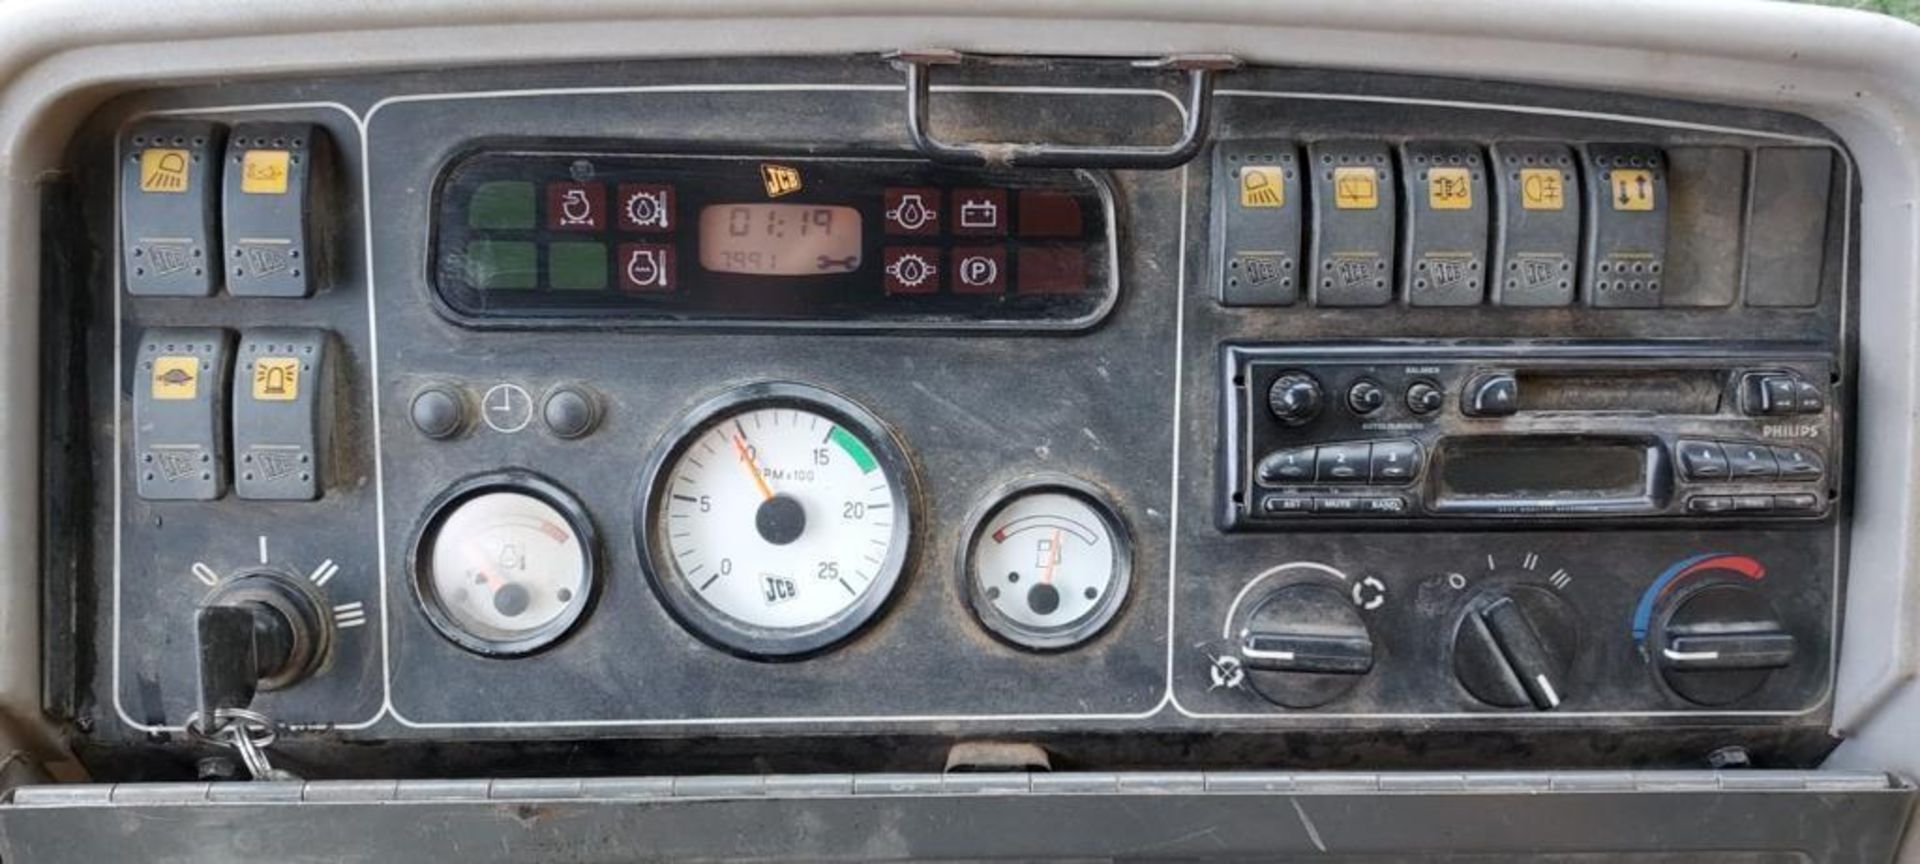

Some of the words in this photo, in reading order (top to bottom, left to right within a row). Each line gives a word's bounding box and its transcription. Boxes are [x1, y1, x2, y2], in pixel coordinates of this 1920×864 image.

[765, 166, 800, 195] JCB
[729, 207, 833, 238] 01:19
[972, 262, 986, 280] P
[1762, 424, 1819, 439] PHILIPS
[812, 448, 830, 466] 15
[1287, 454, 1294, 464] 1
[1336, 453, 1346, 463] 2
[793, 469, 815, 481] 100
[700, 495, 711, 513] 5
[843, 501, 865, 519] 20
[721, 557, 732, 575] 0
[818, 562, 839, 579] 25
[765, 576, 797, 602] JCB
